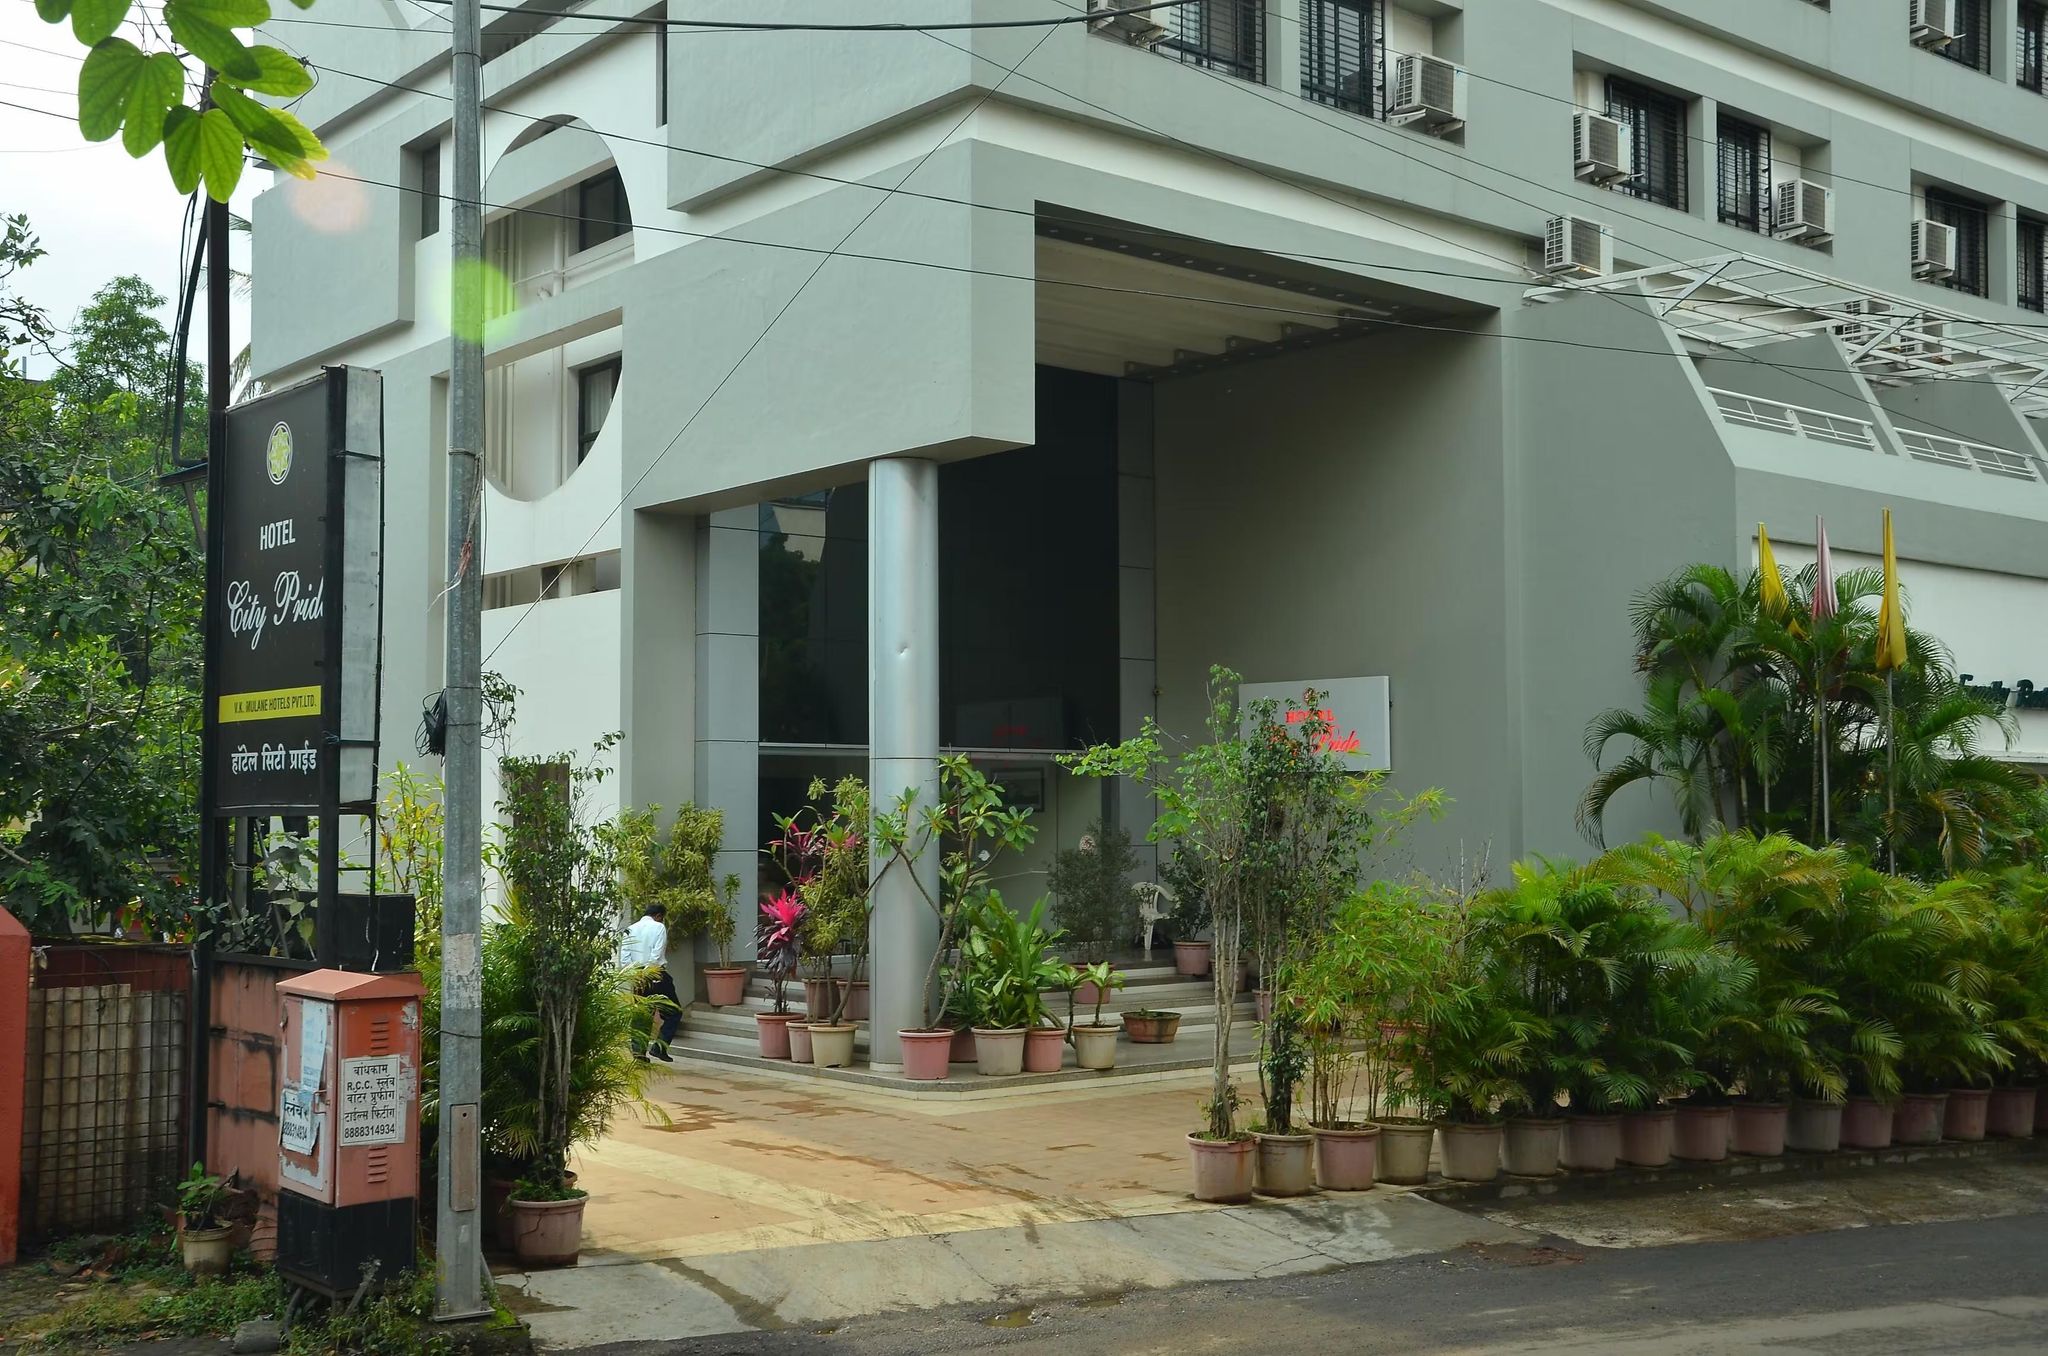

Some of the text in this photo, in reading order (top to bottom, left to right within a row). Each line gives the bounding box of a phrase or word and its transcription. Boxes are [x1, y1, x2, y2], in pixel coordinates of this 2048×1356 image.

[260, 519, 296, 551] HOTEL
[227, 570, 324, 650] City Prid
[269, 696, 290, 711] HOTELS
[231, 740, 317, 775] हॉटेल सिटी प्राईड
[347, 1080, 373, 1092] R.C.C.
[347, 1090, 367, 1103] वॉटर
[344, 1123, 395, 1139] 8888314934
